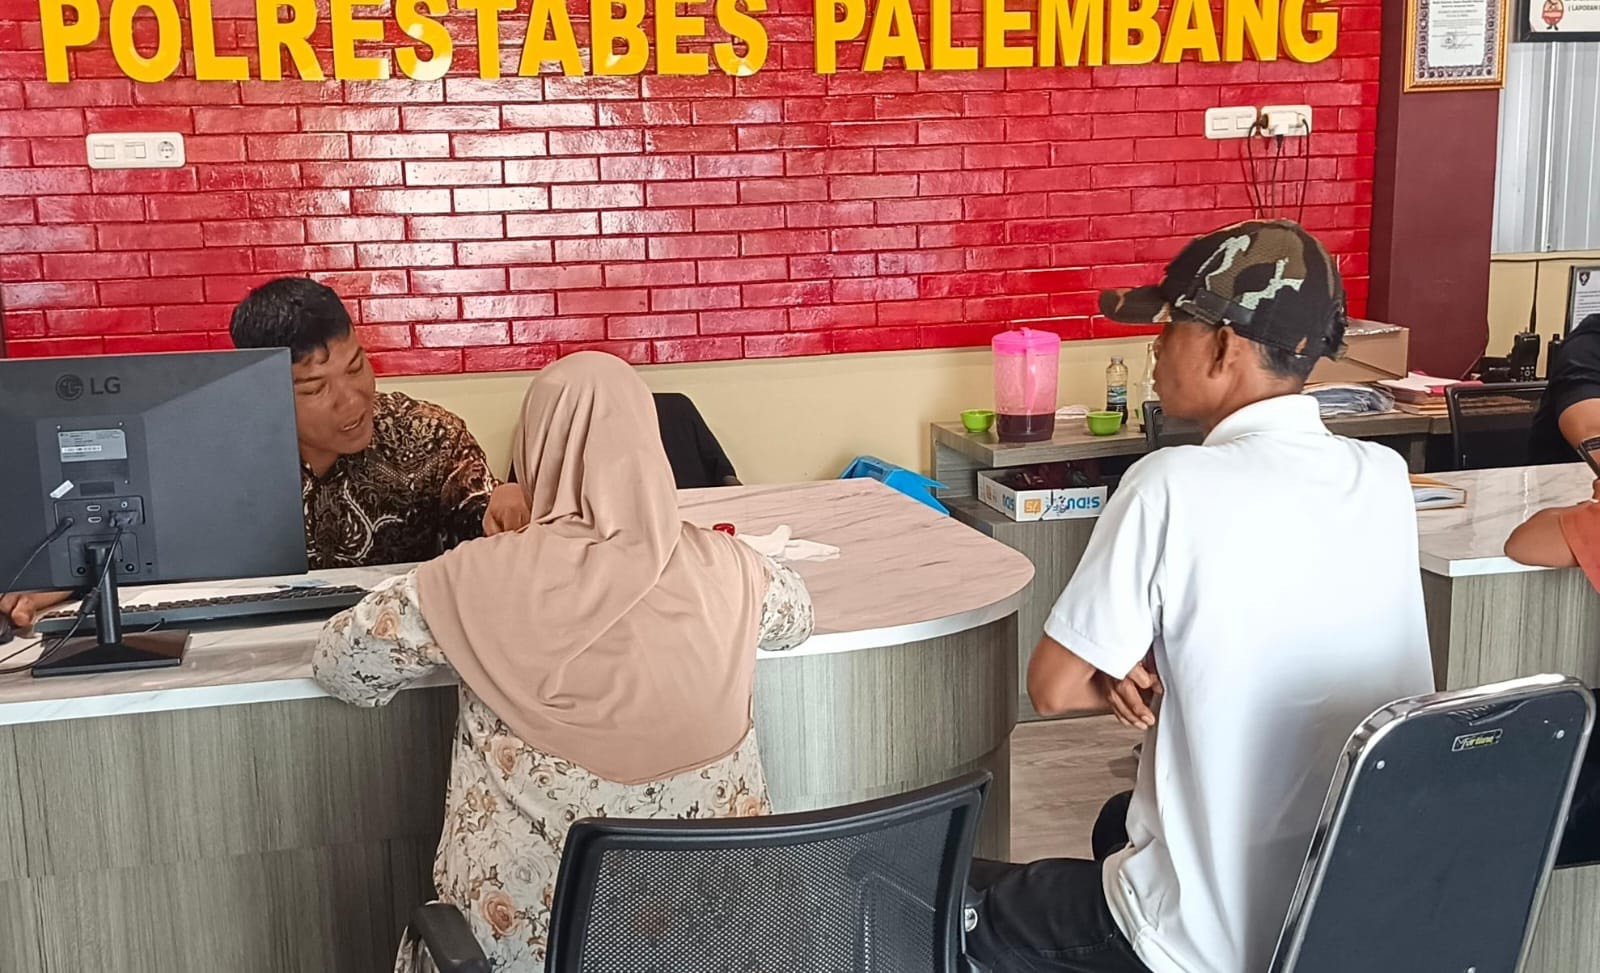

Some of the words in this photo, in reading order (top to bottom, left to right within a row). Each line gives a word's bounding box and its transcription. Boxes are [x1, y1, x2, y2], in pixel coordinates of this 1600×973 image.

[40, 0, 768, 82] POLRESTABES
[814, 0, 1339, 74] PALEMBANG
[90, 376, 121, 395] LG
